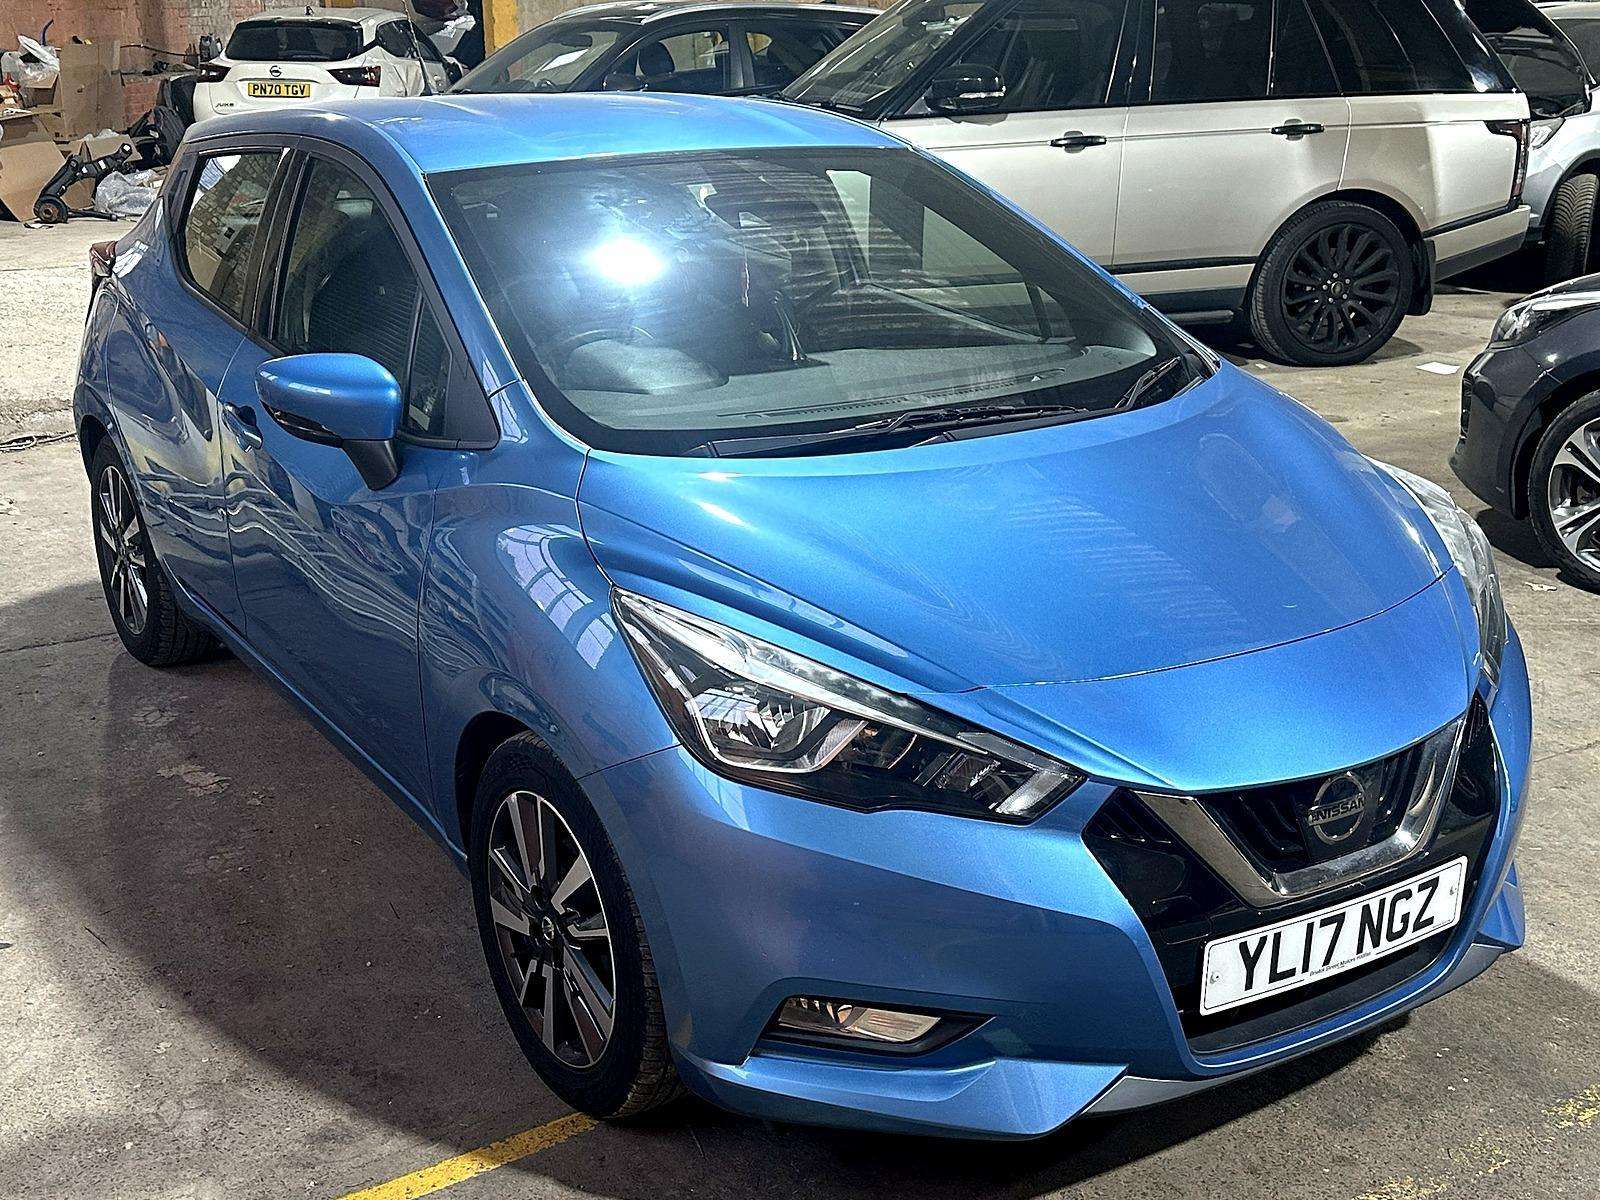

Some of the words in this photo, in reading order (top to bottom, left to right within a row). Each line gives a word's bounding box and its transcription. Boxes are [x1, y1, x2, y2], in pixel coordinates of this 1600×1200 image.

[252, 84, 281, 95] PN70
[284, 84, 306, 96] TGV
[1311, 797, 1364, 822] NISSAN
[1239, 912, 1346, 991] YL17
[1356, 876, 1440, 955] NGZ
